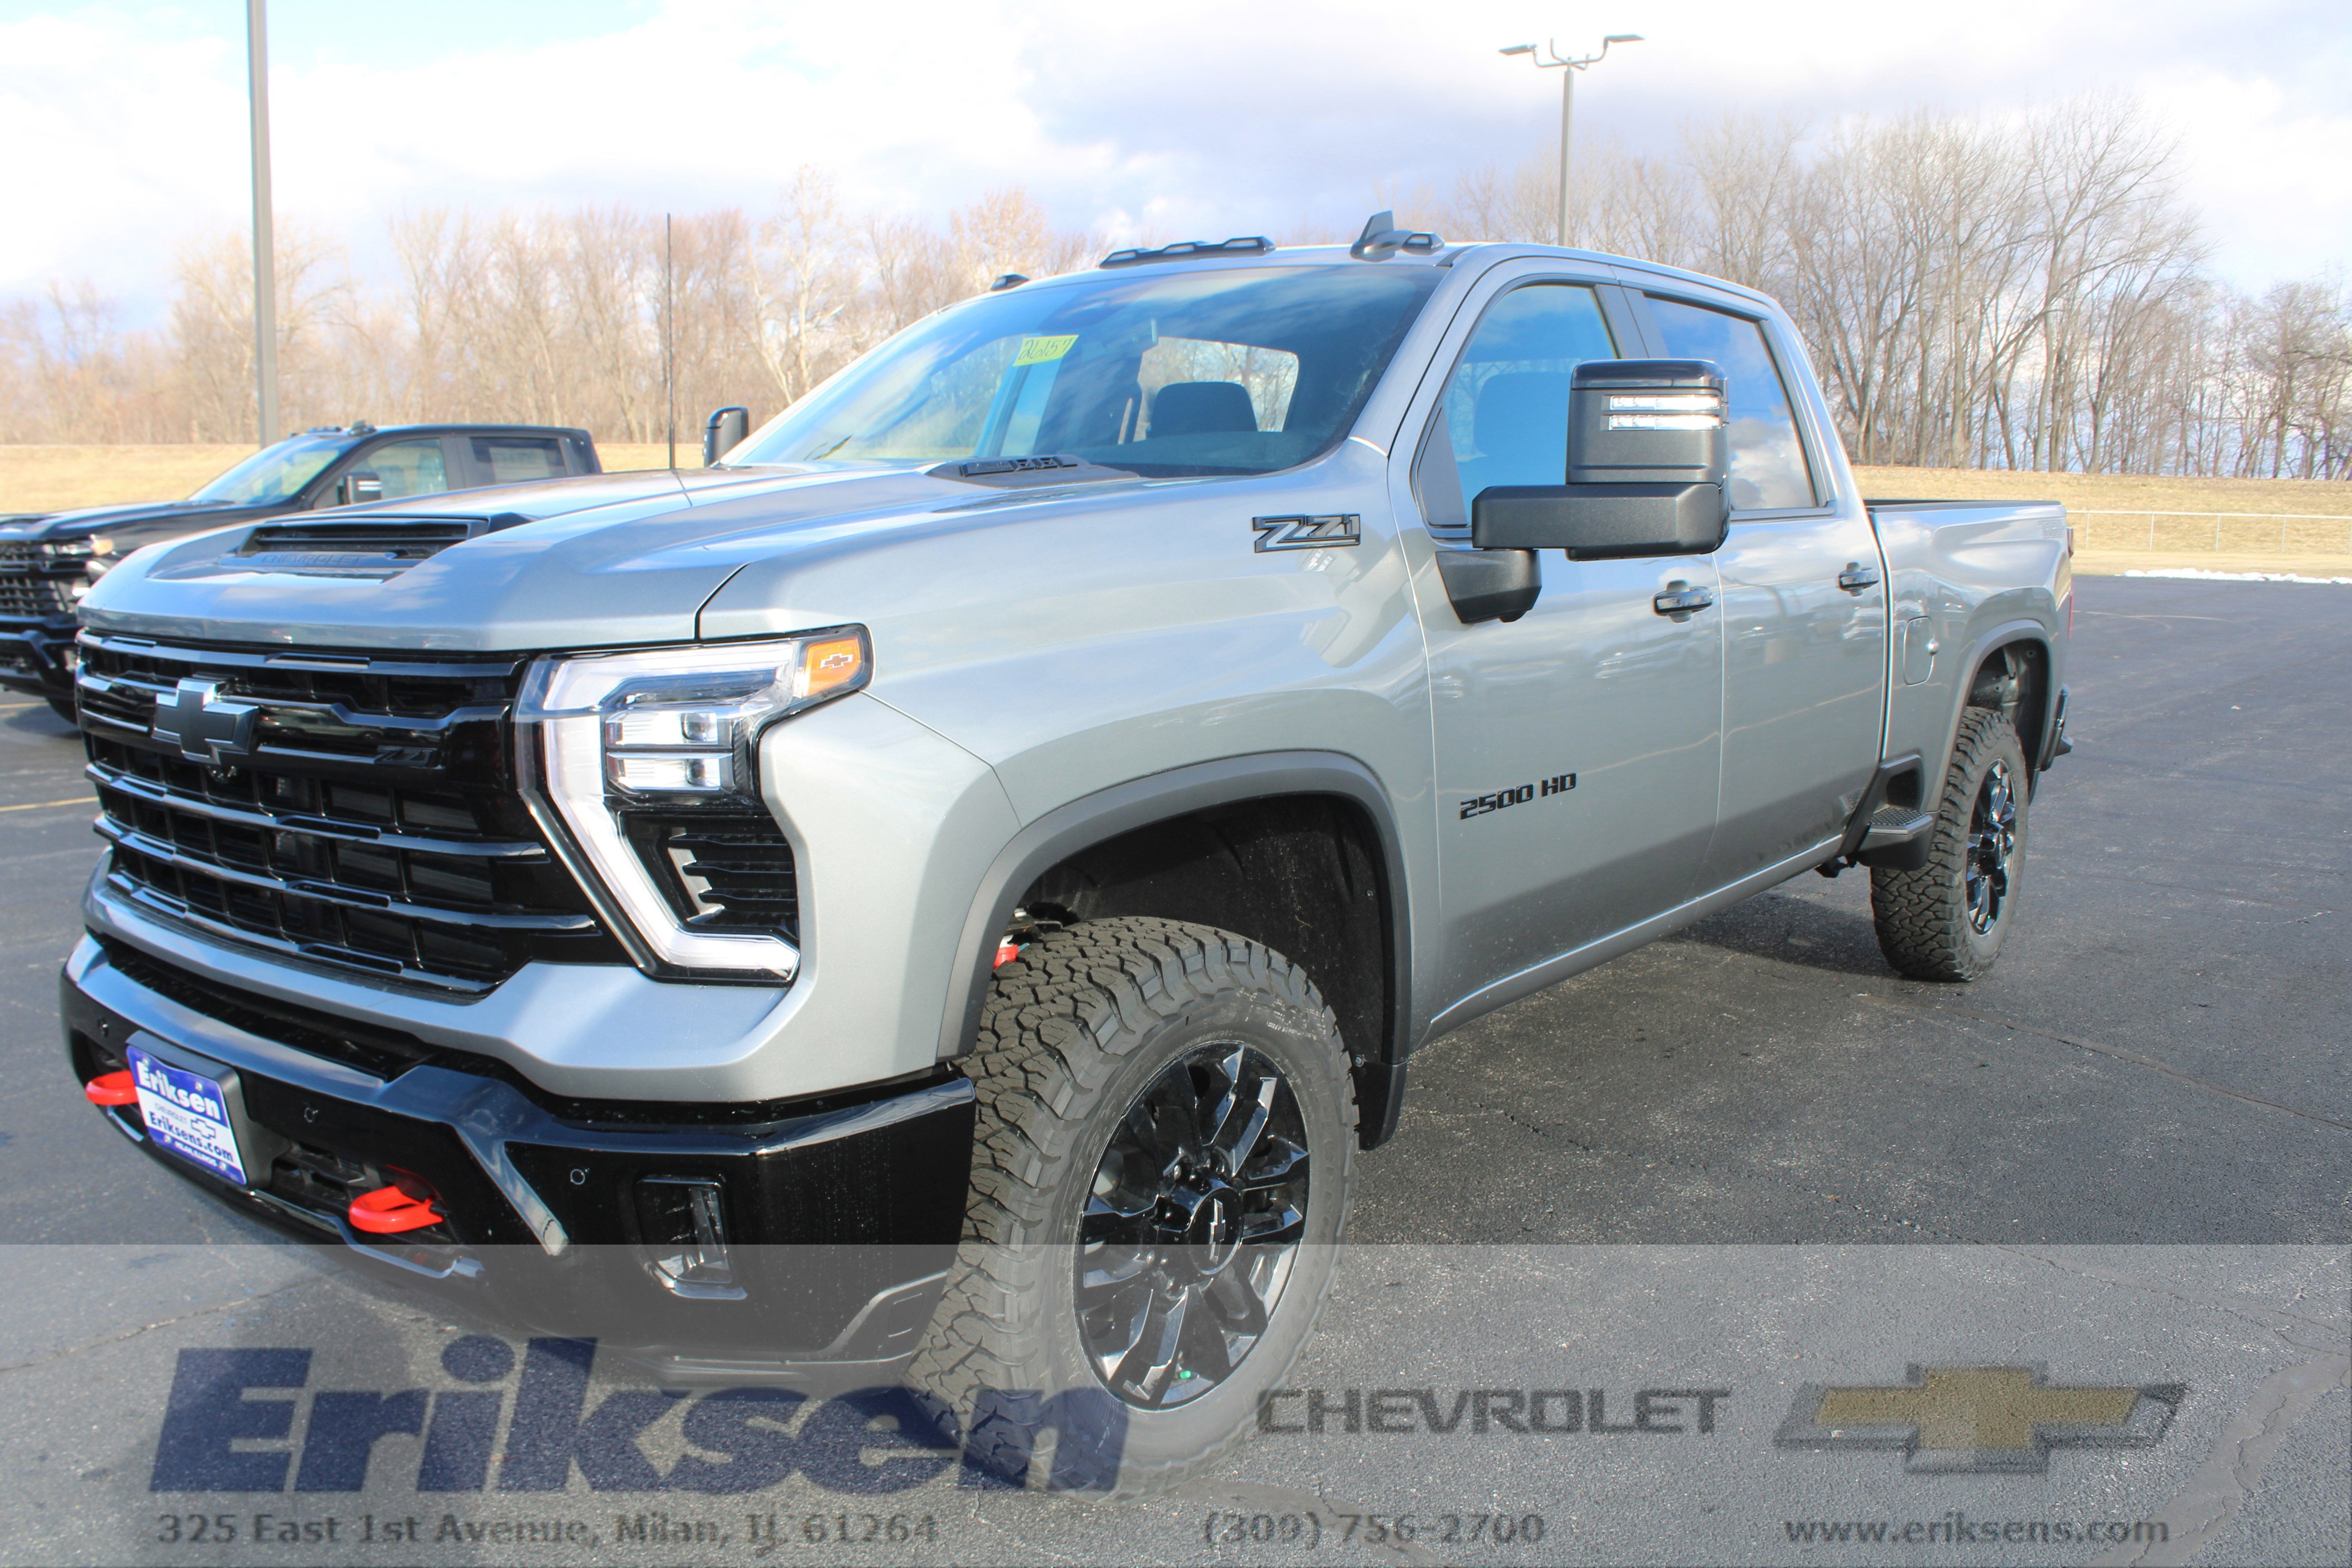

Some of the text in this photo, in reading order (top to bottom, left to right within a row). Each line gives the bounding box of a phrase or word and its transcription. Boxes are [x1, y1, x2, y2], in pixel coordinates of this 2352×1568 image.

[1018, 339, 1072, 360] 26157
[262, 554, 367, 564] CHEVROLET
[1460, 771, 1577, 820] 2500 HD
[136, 1060, 221, 1120] Eriksen
[149, 1110, 234, 1163] Eriksens.com
